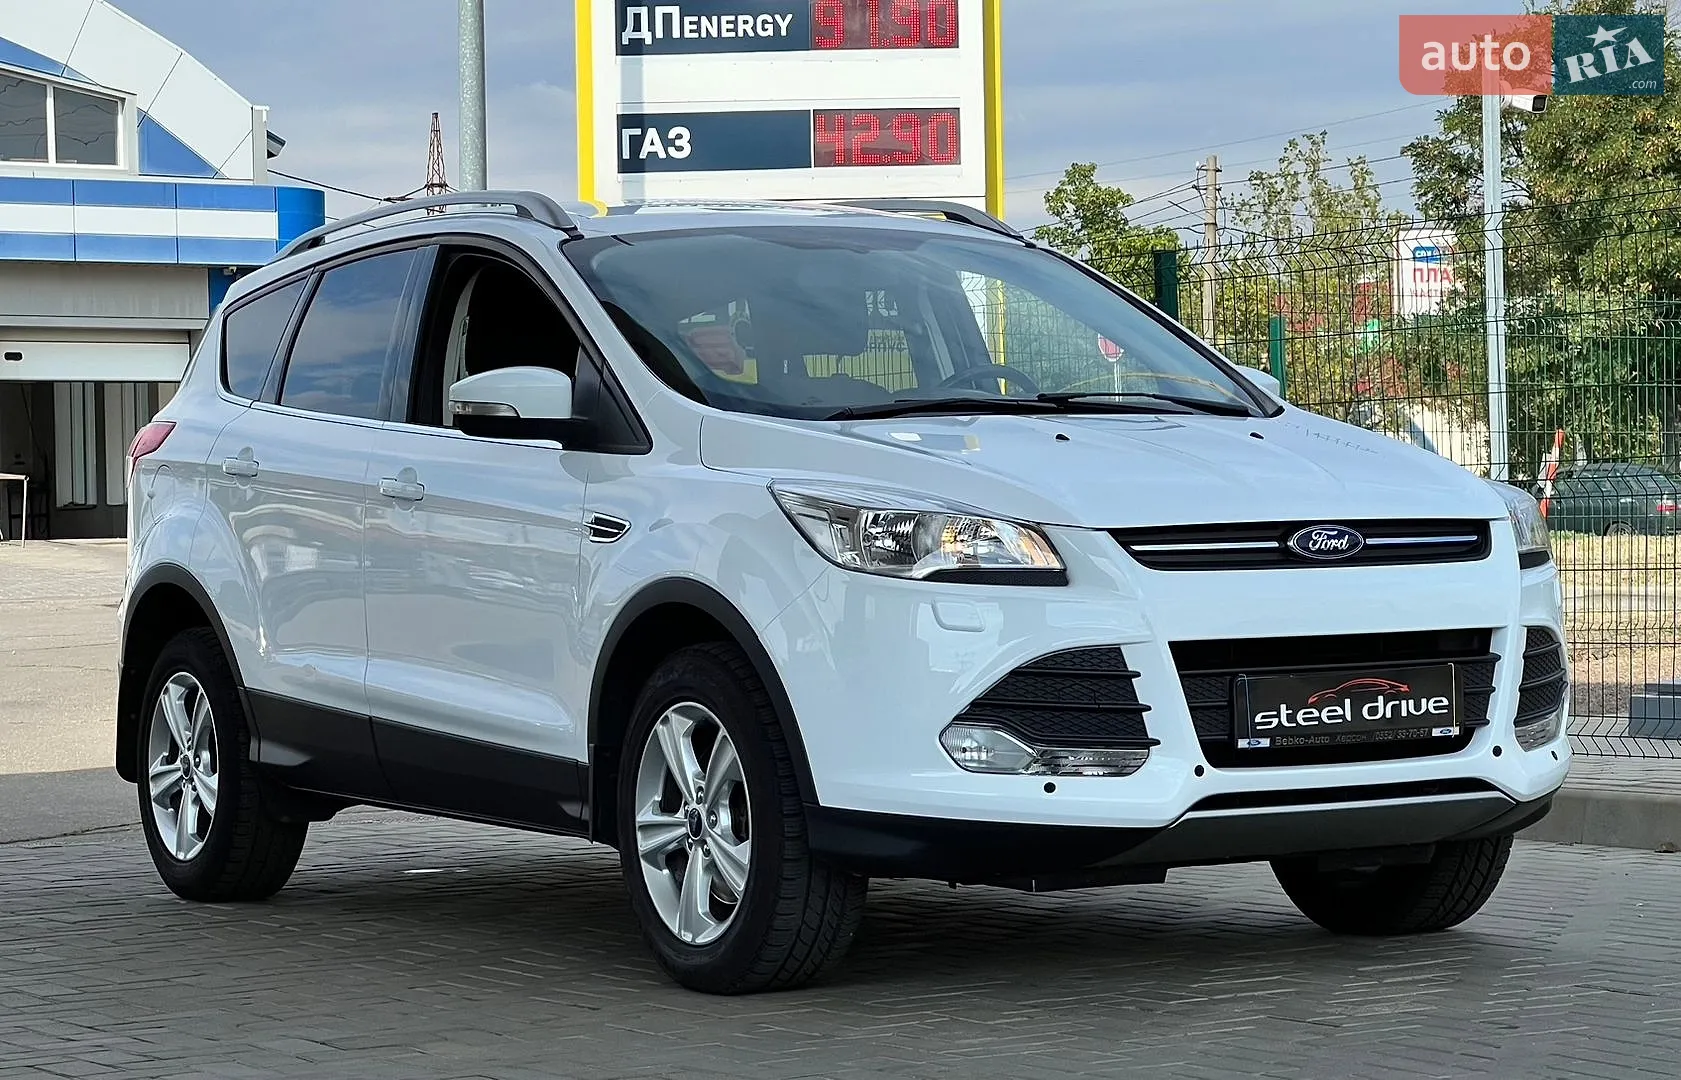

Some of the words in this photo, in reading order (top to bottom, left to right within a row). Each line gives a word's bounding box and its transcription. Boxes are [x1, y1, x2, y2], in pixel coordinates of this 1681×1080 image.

[621, 126, 692, 160] ГАЗ
[815, 112, 958, 165] 42.90
[1308, 529, 1350, 551] Ford
[1254, 698, 1352, 730] steel
[1362, 695, 1449, 721] drive
